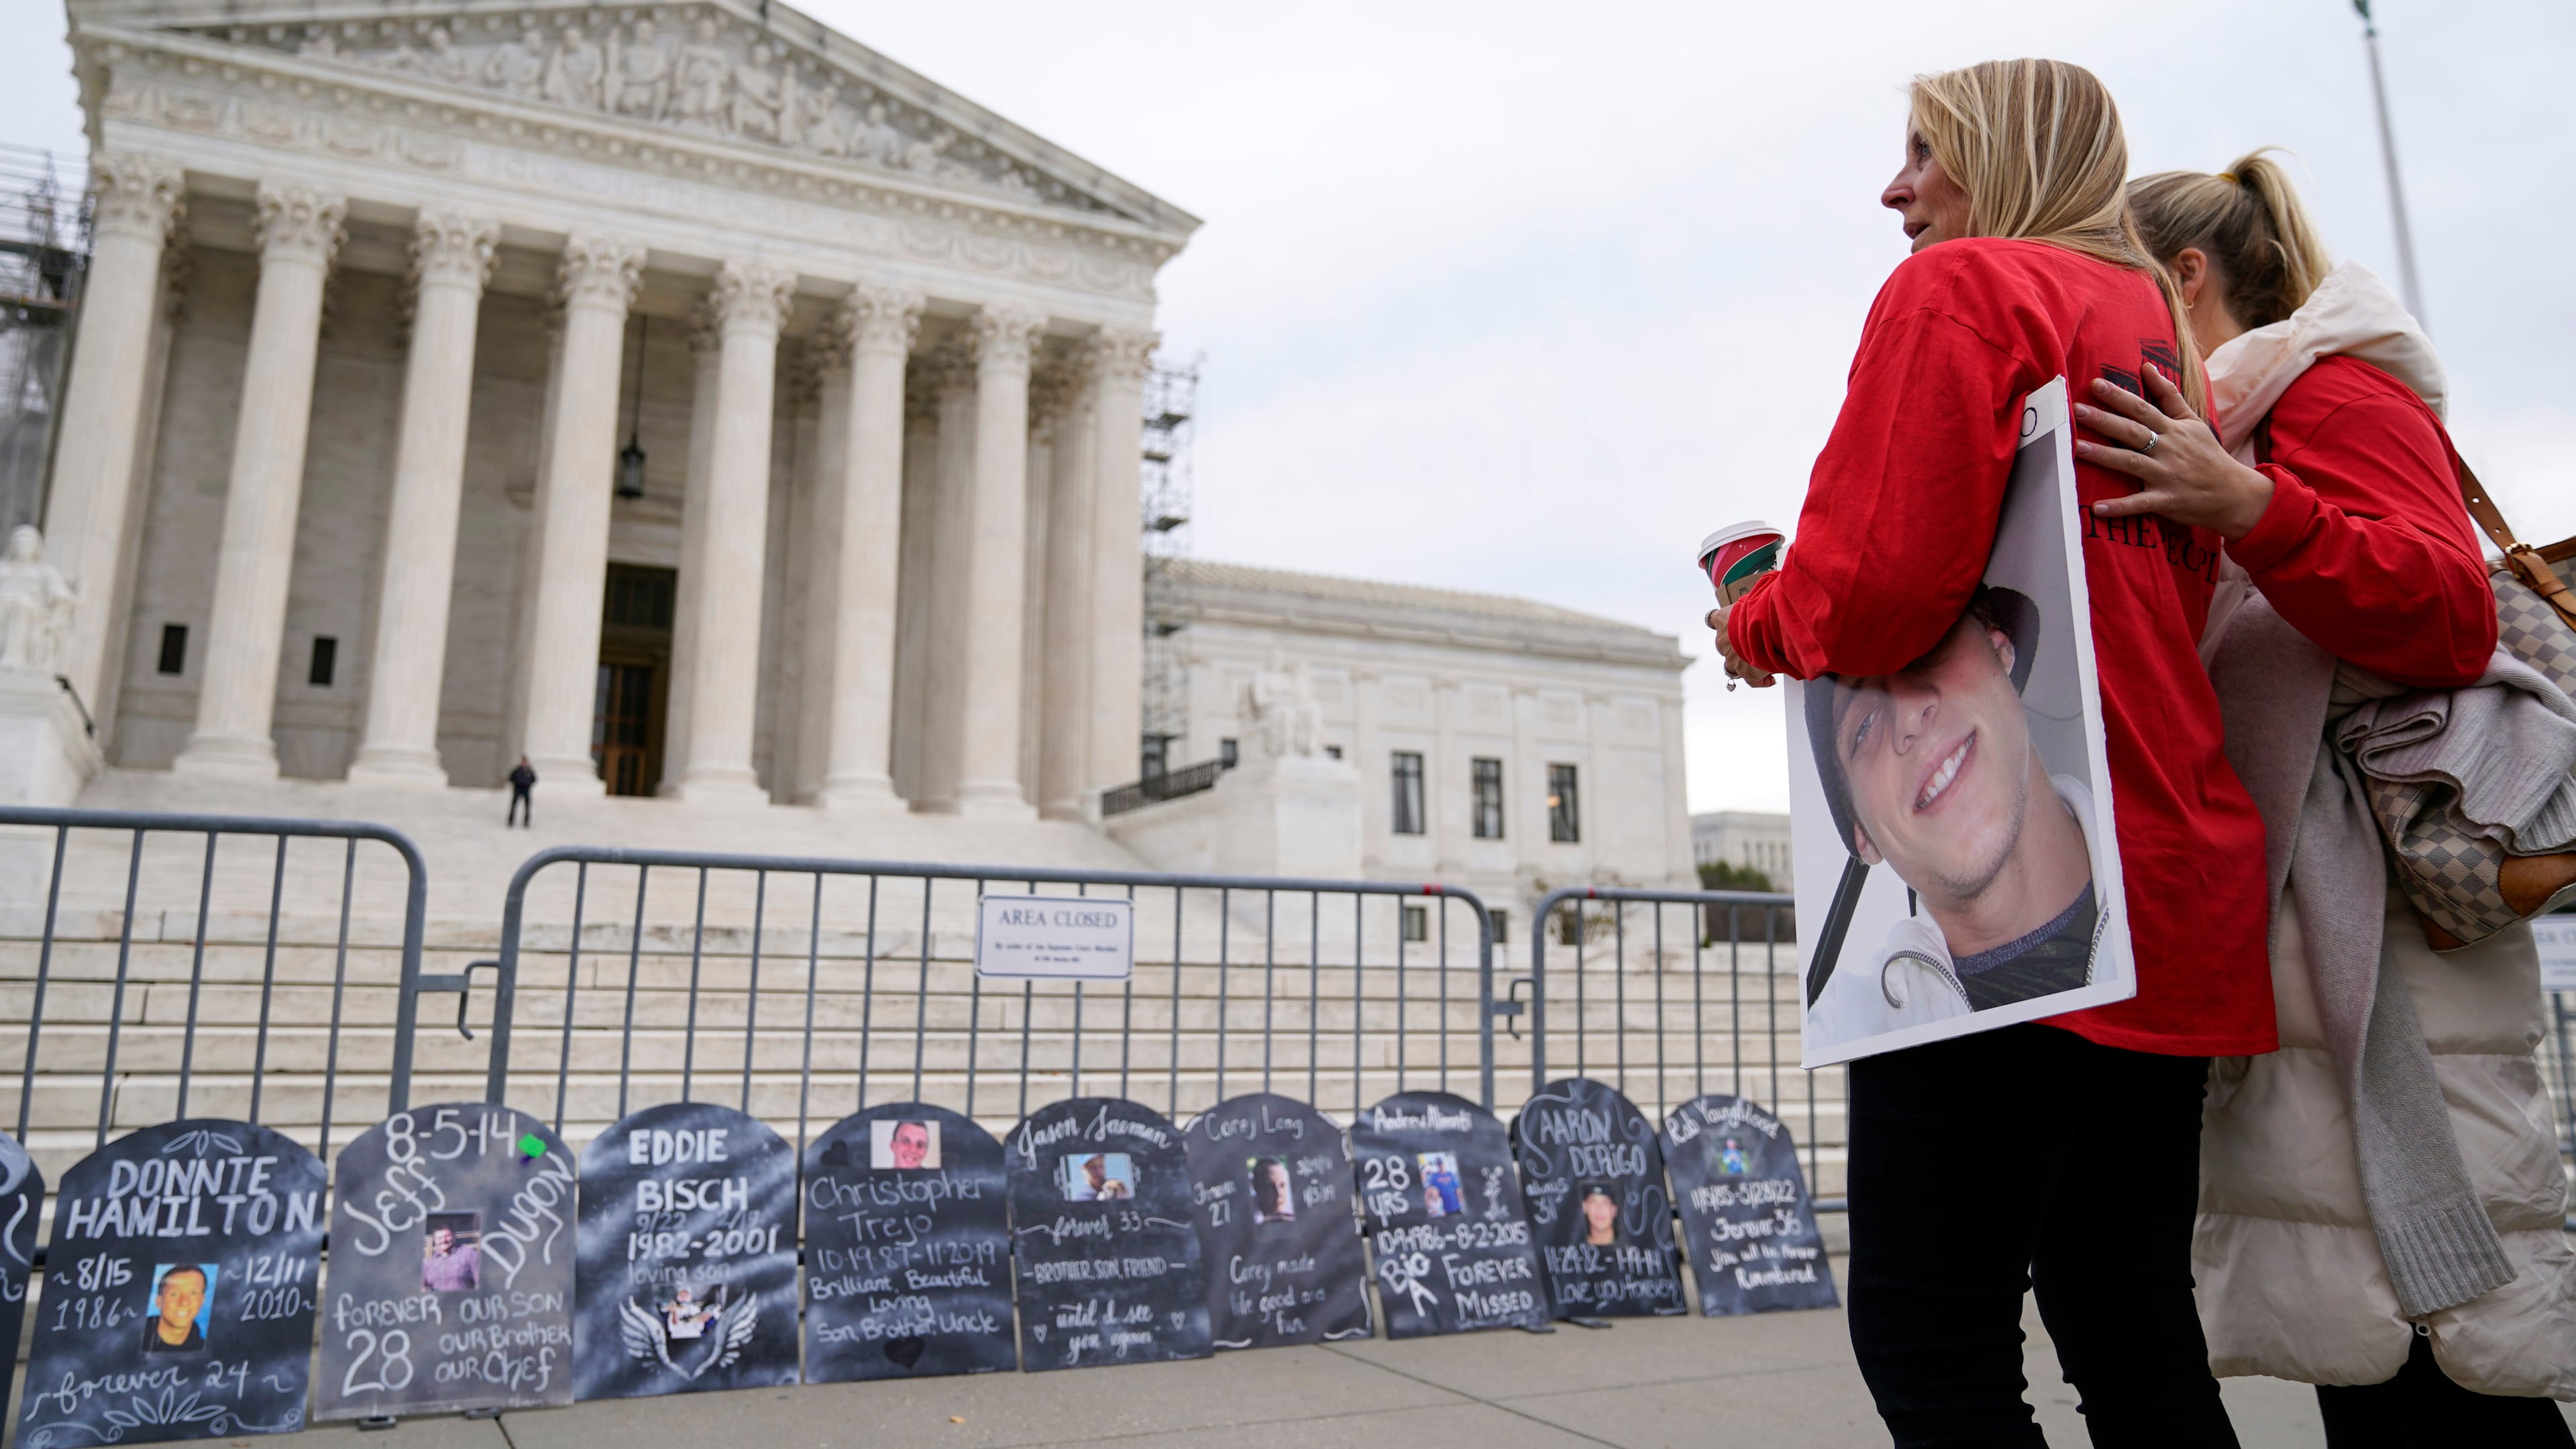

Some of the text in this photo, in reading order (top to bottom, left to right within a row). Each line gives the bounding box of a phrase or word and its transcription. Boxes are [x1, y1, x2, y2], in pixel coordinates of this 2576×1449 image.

[1000, 909, 1118, 928] AREA CLOSED
[384, 1108, 517, 1163] 8-5-14
[1018, 1117, 1081, 1171] Jason
[1540, 1108, 1611, 1144] AARON
[629, 1128, 729, 1166] EDDIE
[107, 1157, 278, 1198] DONNIE
[810, 1170, 991, 1213] Christopher
[1364, 1155, 1410, 1191] 28
[636, 1176, 749, 1213] BISCH
[65, 1191, 318, 1239] HAMILTON
[837, 1210, 933, 1247] Trejo
[1119, 1211, 1142, 1232] 33
[905, 1266, 990, 1290] Beautiful
[460, 1291, 564, 1324] OUR SON
[939, 1309, 1001, 1334] Uncle
[439, 1331, 491, 1356] OUR
[205, 1359, 250, 1400] 24
[340, 1328, 415, 1399] 28
